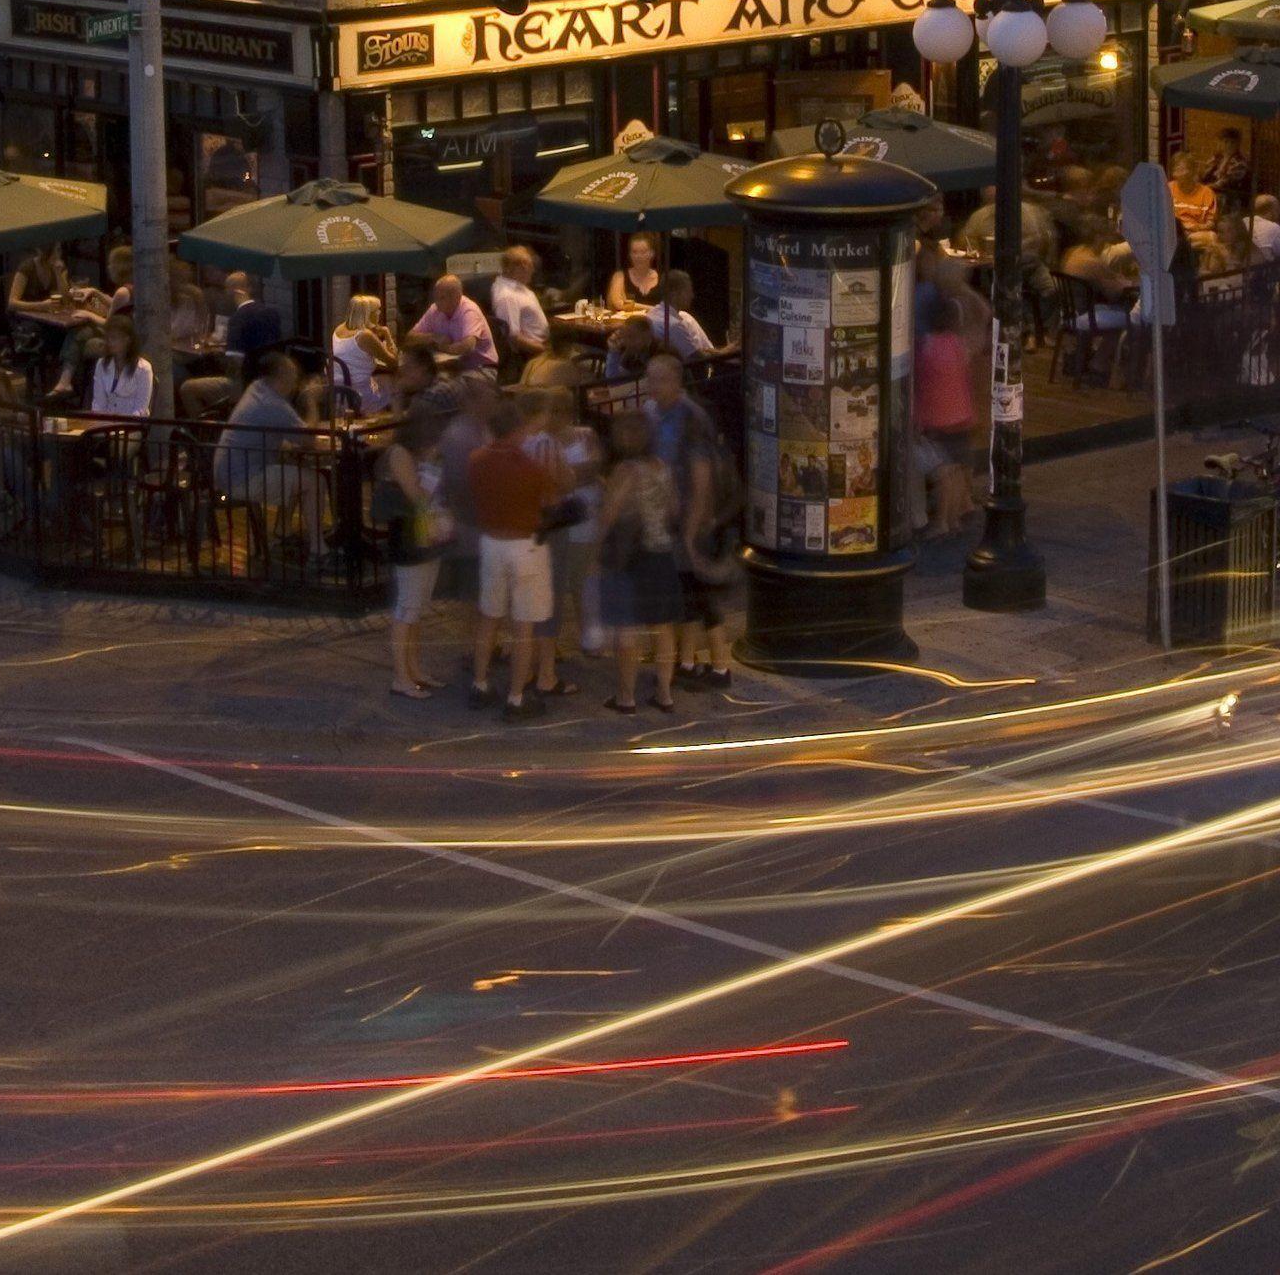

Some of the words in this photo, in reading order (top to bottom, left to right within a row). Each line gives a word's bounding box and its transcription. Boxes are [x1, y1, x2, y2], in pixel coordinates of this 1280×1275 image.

[24, 4, 76, 36] IRISH
[363, 30, 430, 69] STOUTS
[811, 242, 871, 258] Market
